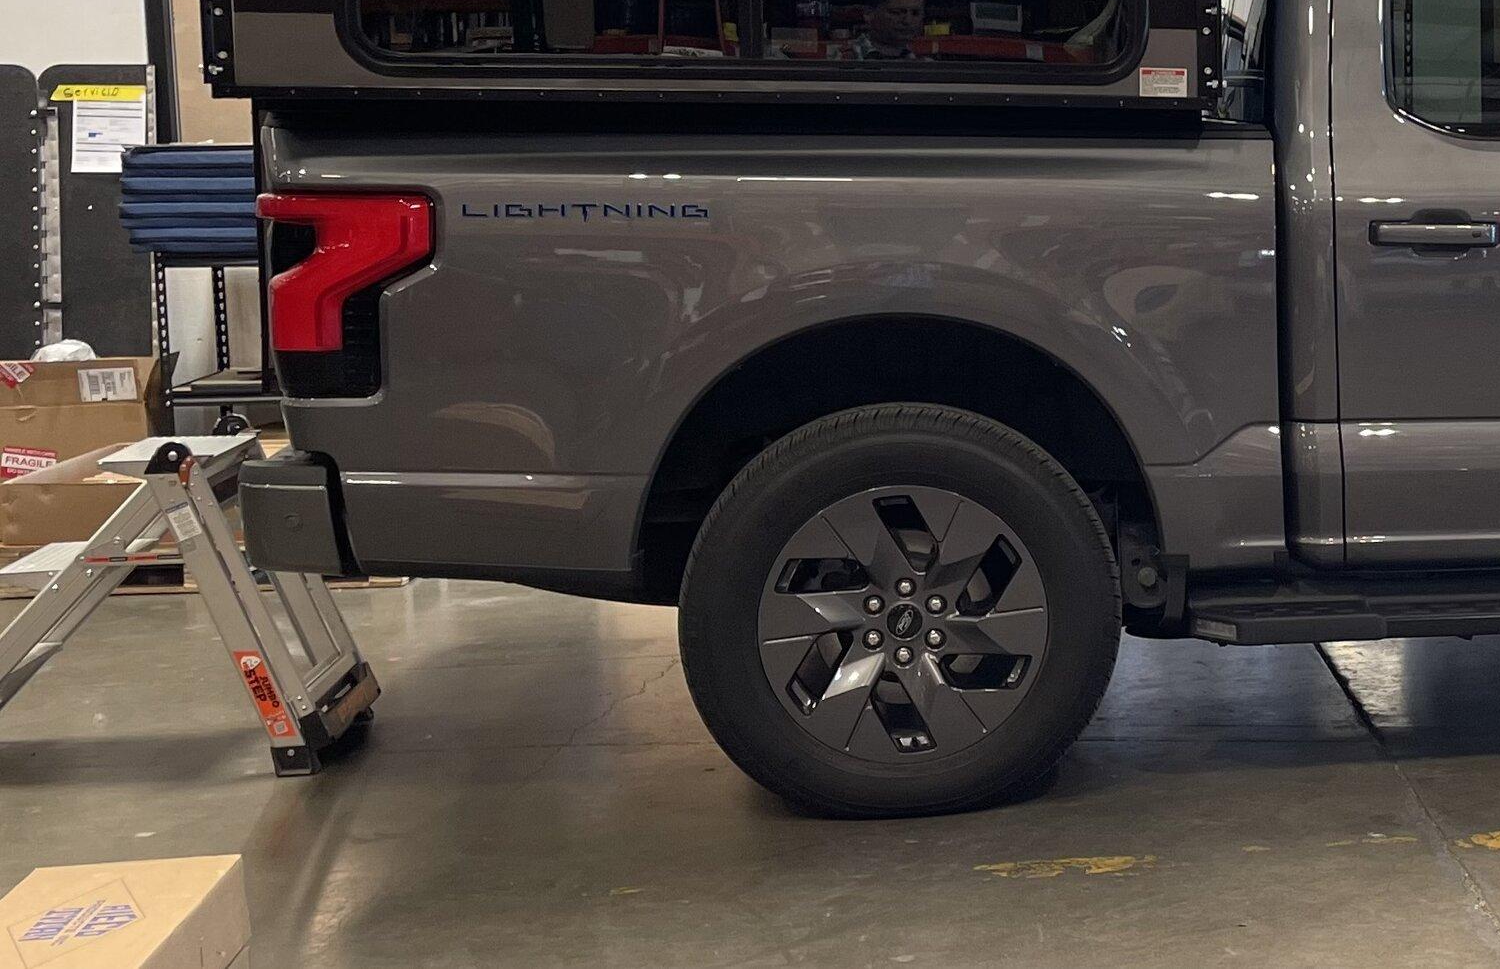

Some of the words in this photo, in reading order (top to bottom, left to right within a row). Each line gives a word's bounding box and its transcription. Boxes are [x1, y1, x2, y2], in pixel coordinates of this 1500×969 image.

[461, 202, 710, 222] LIGHTNING
[243, 669, 268, 703] STEP
[259, 673, 280, 708] JUMBO
